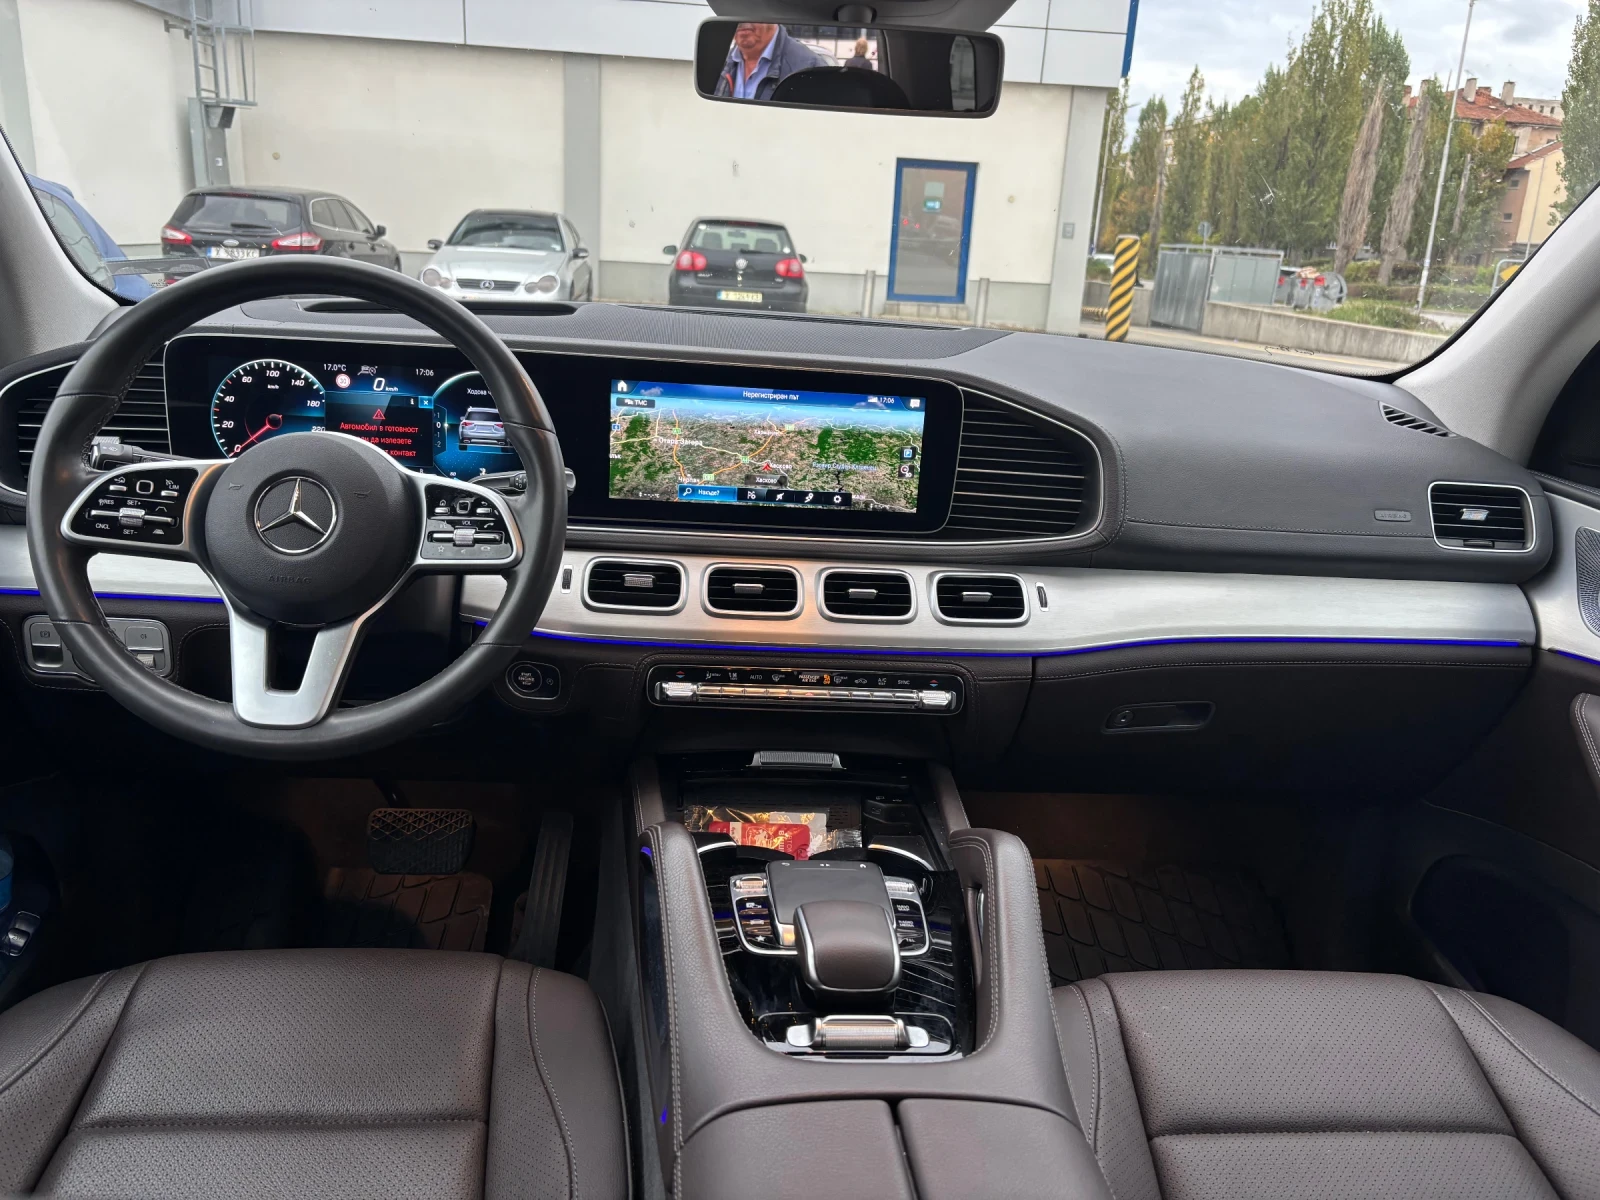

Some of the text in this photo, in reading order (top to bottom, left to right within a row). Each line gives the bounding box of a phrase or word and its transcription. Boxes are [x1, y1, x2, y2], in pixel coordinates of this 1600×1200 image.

[323, 363, 347, 372] 17.0°C
[415, 368, 435, 377] 17:06
[291, 379, 305, 387] 140
[373, 377, 385, 391] 0
[340, 422, 378, 431] Автомобил
[381, 437, 412, 445] излезете
[95, 522, 111, 530] CNCL
